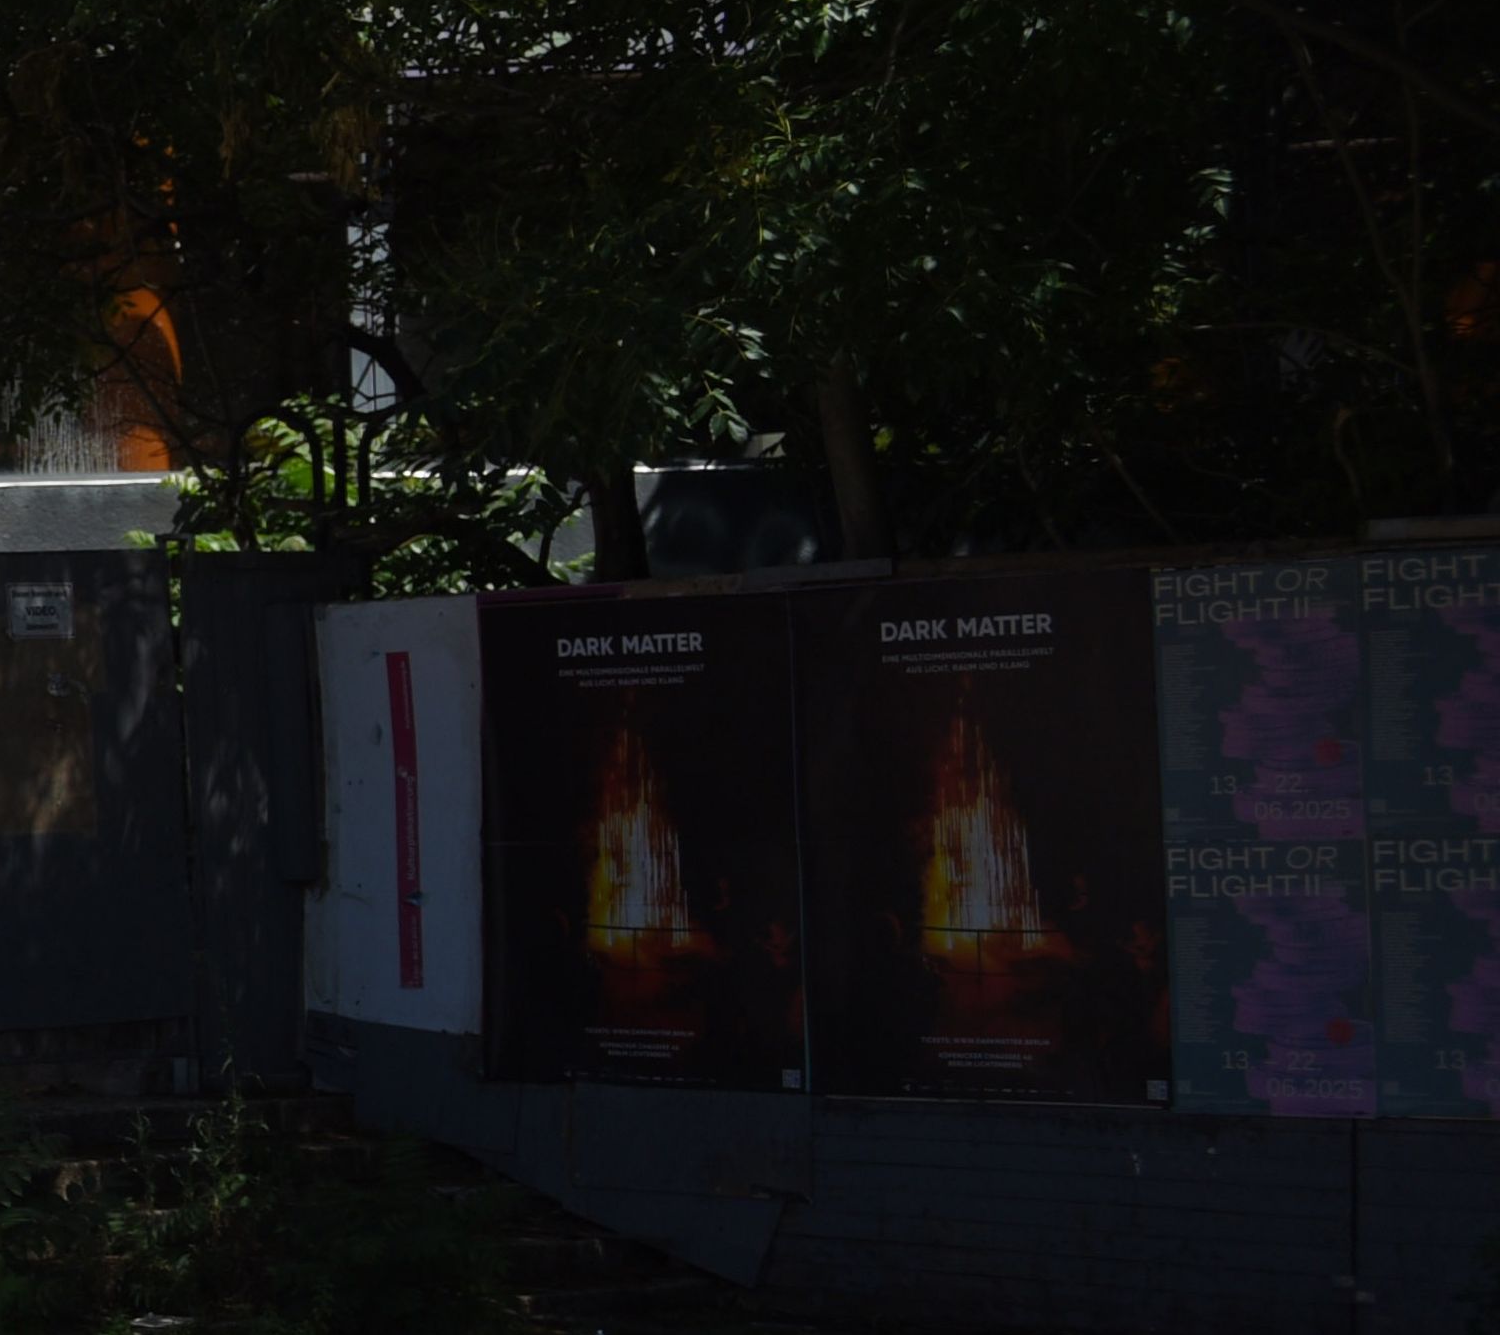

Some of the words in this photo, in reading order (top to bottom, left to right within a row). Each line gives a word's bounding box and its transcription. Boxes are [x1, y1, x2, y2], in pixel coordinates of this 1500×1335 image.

[1154, 571, 1263, 599] FIGHT
[1275, 568, 1328, 592] OR
[1156, 598, 1287, 626] FLIGHT
[1293, 597, 1309, 620] II
[557, 636, 614, 658] DARK
[622, 632, 703, 655] MATTER
